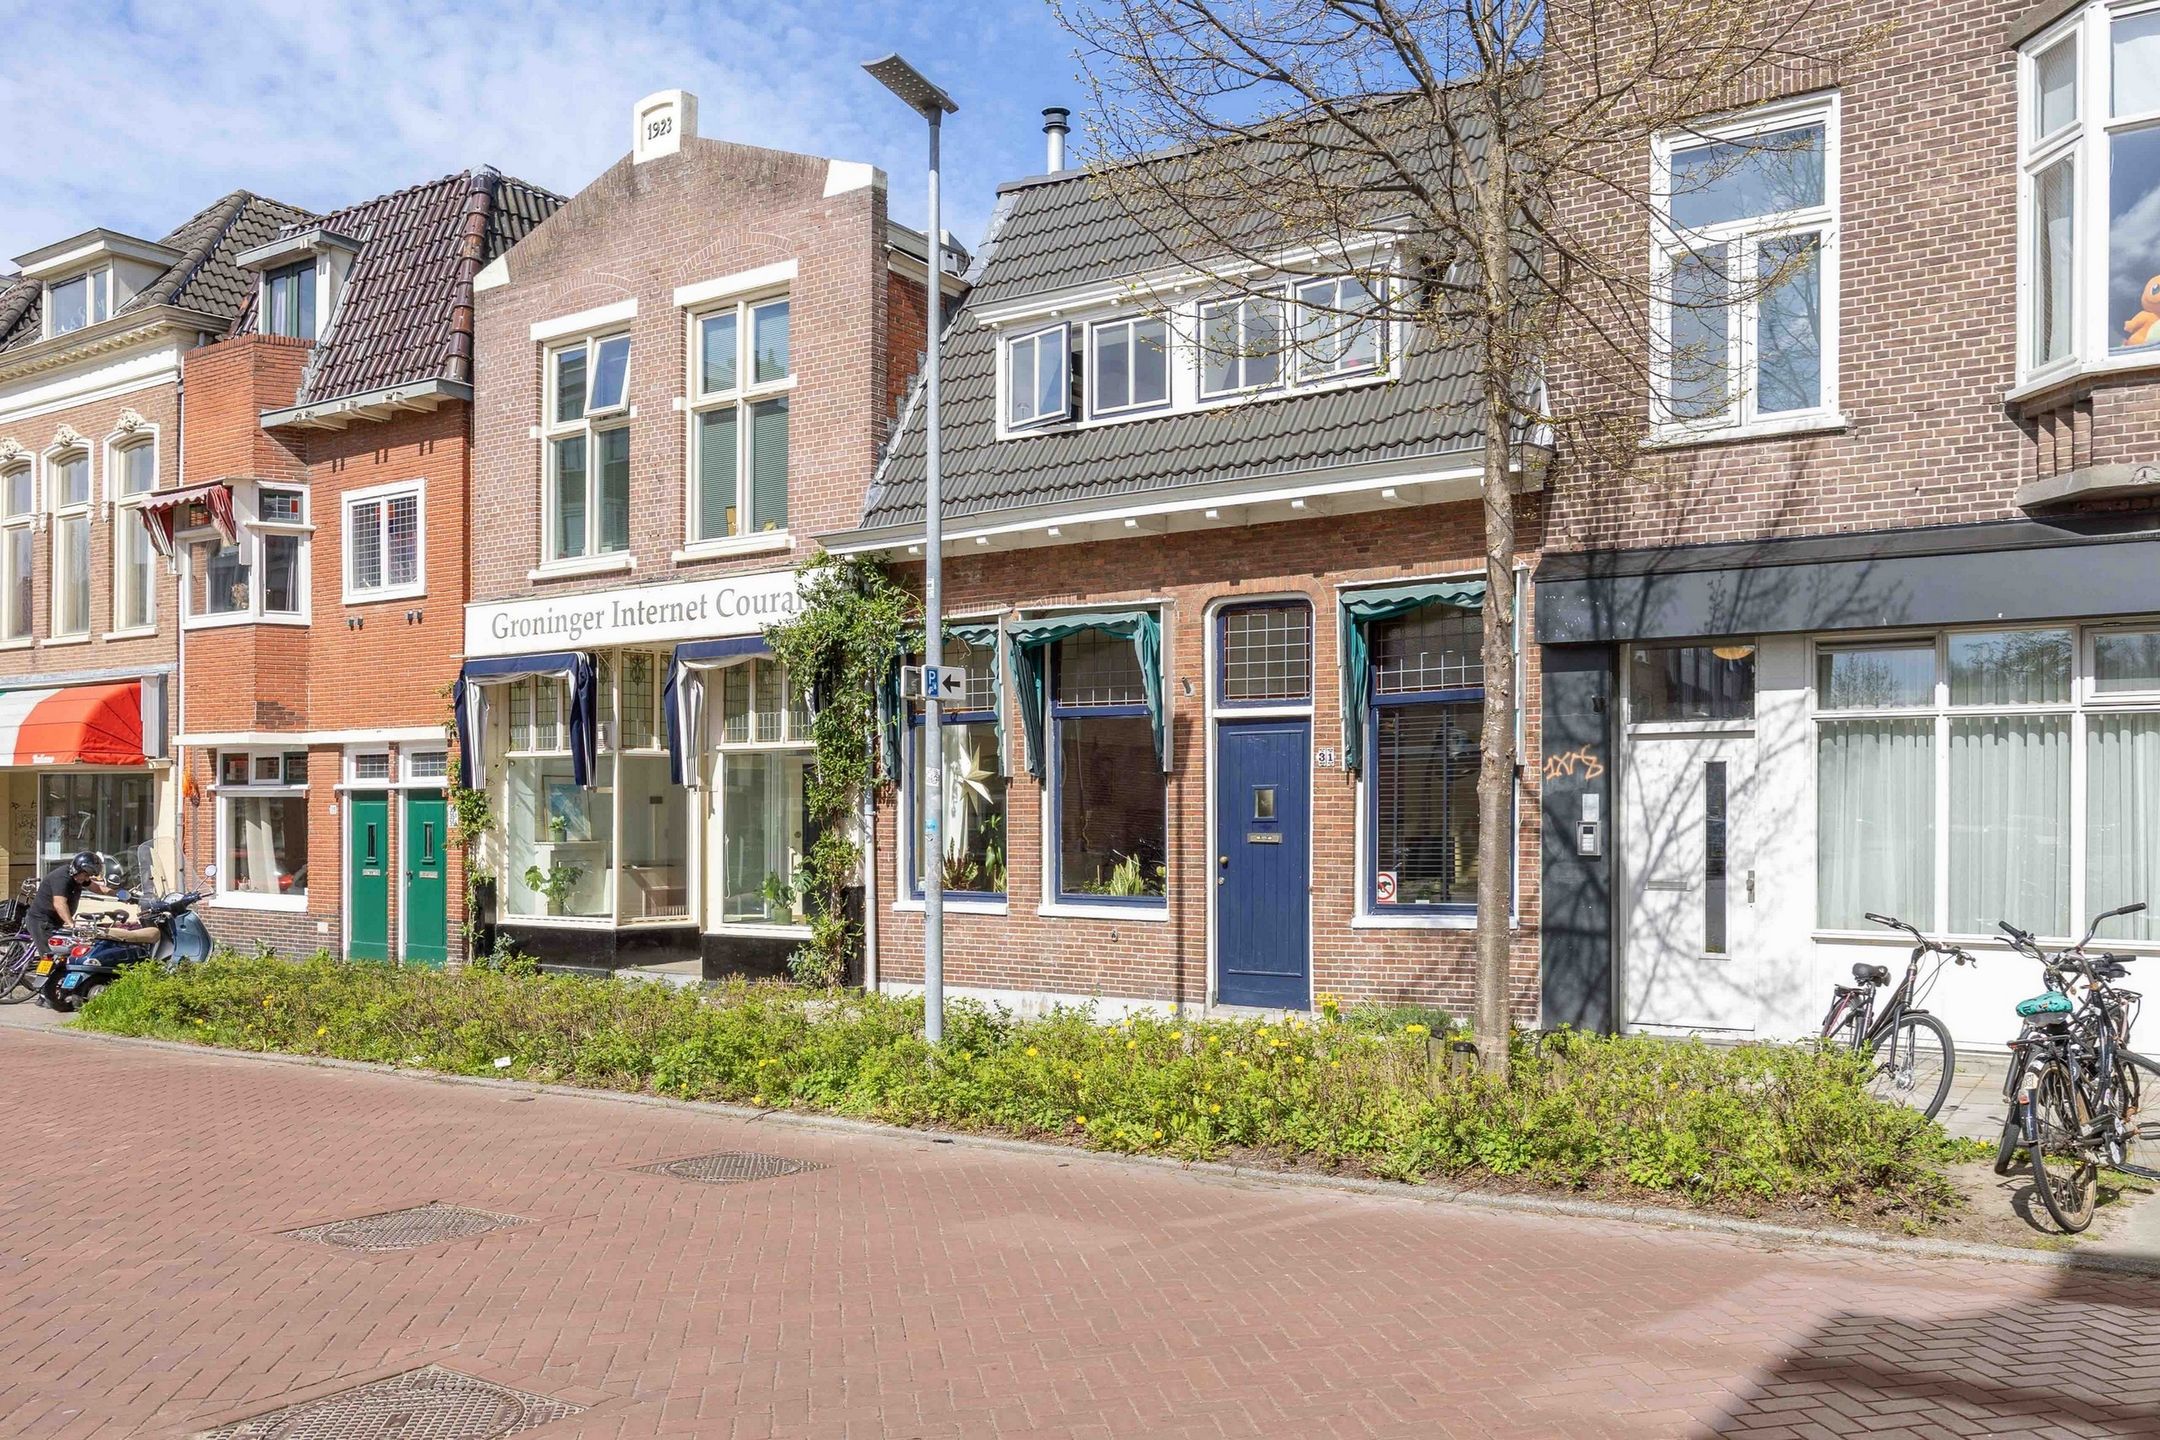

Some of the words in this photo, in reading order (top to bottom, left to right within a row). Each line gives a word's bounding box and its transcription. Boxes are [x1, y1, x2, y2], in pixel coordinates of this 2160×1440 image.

[647, 116, 673, 140] 1923
[491, 607, 605, 641] Groninger
[611, 593, 708, 628] Internet
